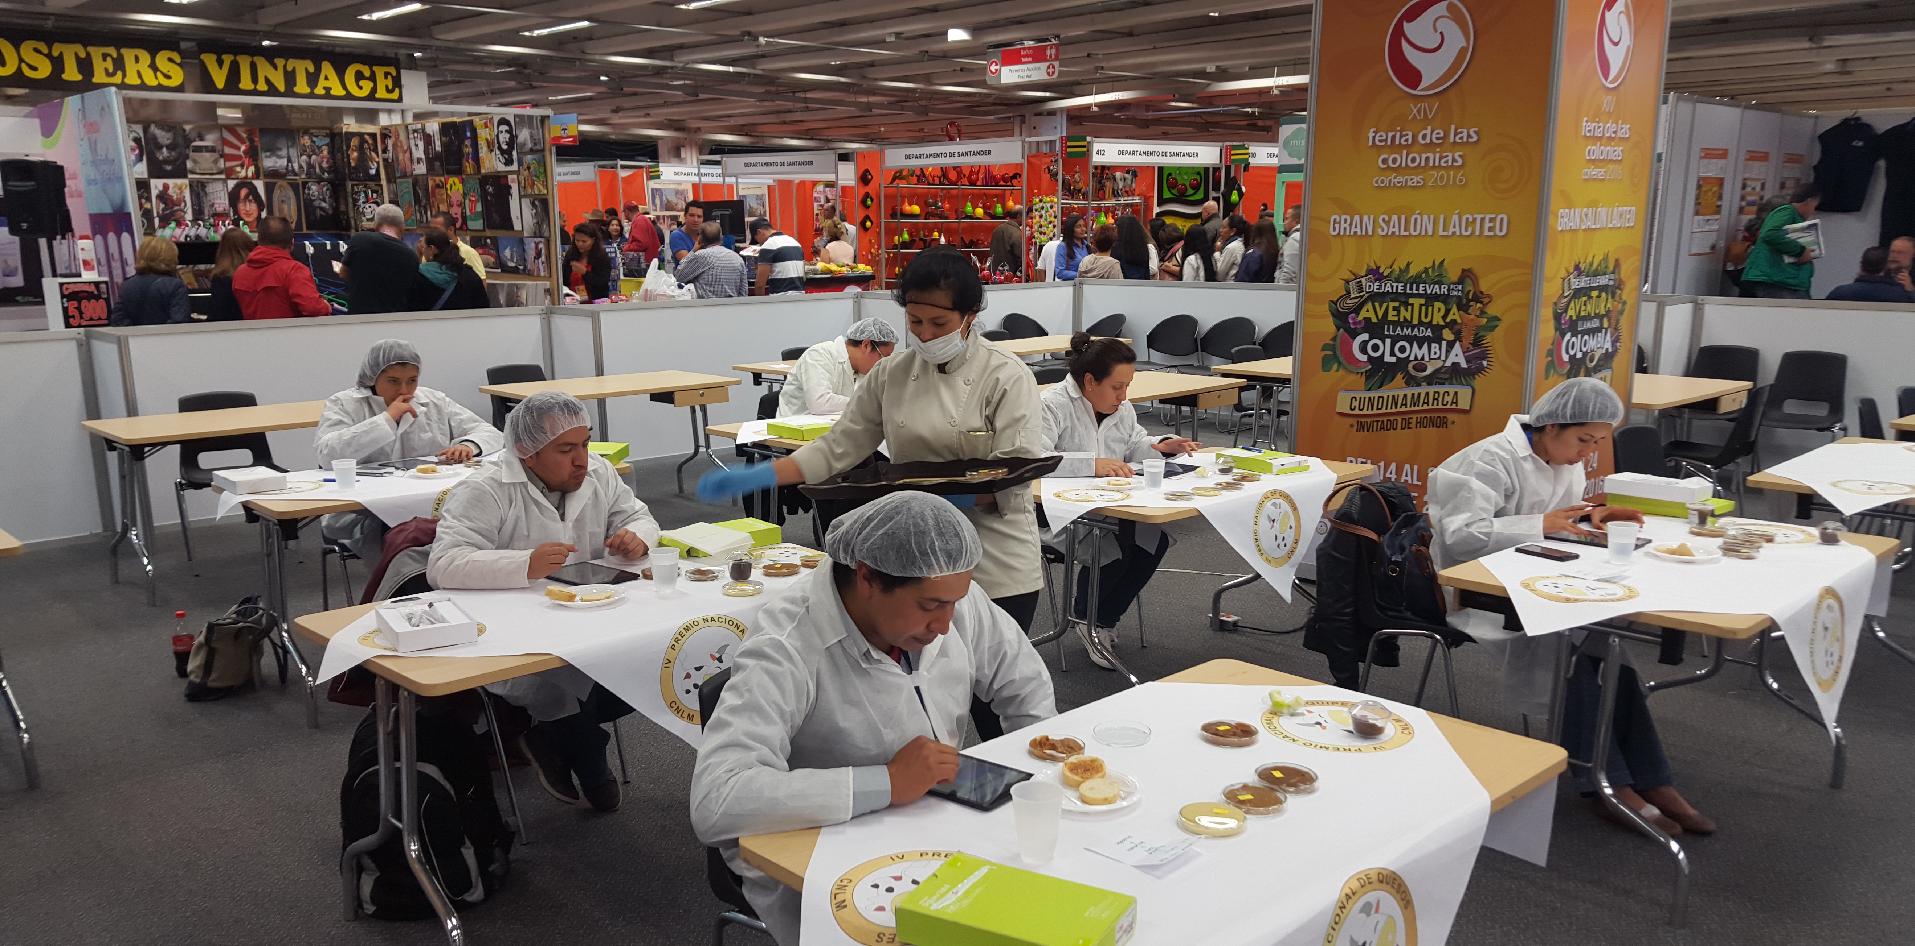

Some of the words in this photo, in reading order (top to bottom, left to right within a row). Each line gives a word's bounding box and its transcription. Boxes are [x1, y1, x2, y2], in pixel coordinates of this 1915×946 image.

[200, 52, 399, 100] VINTAGE
[1408, 102, 1439, 120] XIV
[1368, 128, 1413, 147] feria
[1418, 126, 1444, 143] de
[1449, 124, 1479, 143] las
[1582, 117, 1603, 137] feria
[1604, 120, 1617, 137] de
[1617, 120, 1630, 138] las
[904, 152, 948, 160] DEPARTAMENTO
[957, 149, 992, 158] SANTANDER
[1118, 149, 1161, 157] DEPARTAMENTO
[1168, 151, 1199, 159] SANTANDER
[1378, 149, 1463, 169] colonias
[1586, 143, 1623, 160] colonias
[1373, 173, 1424, 188] corferias
[1428, 171, 1466, 186] 2016
[1330, 214, 1374, 236] GRAN
[1377, 211, 1436, 236] SALÓN
[1439, 210, 1508, 236] LÁCTEO
[1558, 207, 1581, 231] GRAN
[1581, 204, 1607, 229] SALÓN
[1607, 204, 1636, 228] LÁCTEO
[1366, 281, 1405, 293] DÉJATE
[1406, 283, 1448, 295] LLEVAR
[1358, 298, 1462, 325] AVENTURA
[1567, 290, 1612, 320] AVENTURA
[1384, 325, 1433, 337] LLAMADA
[1352, 332, 1468, 368] COLOMBIA
[1561, 328, 1613, 361] COLOMBIA
[1349, 391, 1459, 411] CUNDINAMARCA
[1356, 419, 1398, 432] INVITADO
[1400, 418, 1412, 430] DE
[1416, 416, 1448, 429] HONOR
[1377, 461, 1397, 481] 14
[1400, 464, 1422, 486] AL
[664, 658, 672, 669] IV
[670, 620, 700, 651] PREMIO
[669, 700, 695, 722] CNLM
[1303, 742, 1362, 752] PREMIO
[890, 854, 905, 862] IV
[833, 878, 852, 912] CNLM
[1356, 873, 1373, 888] DE
[1377, 872, 1411, 910] QUESOS
